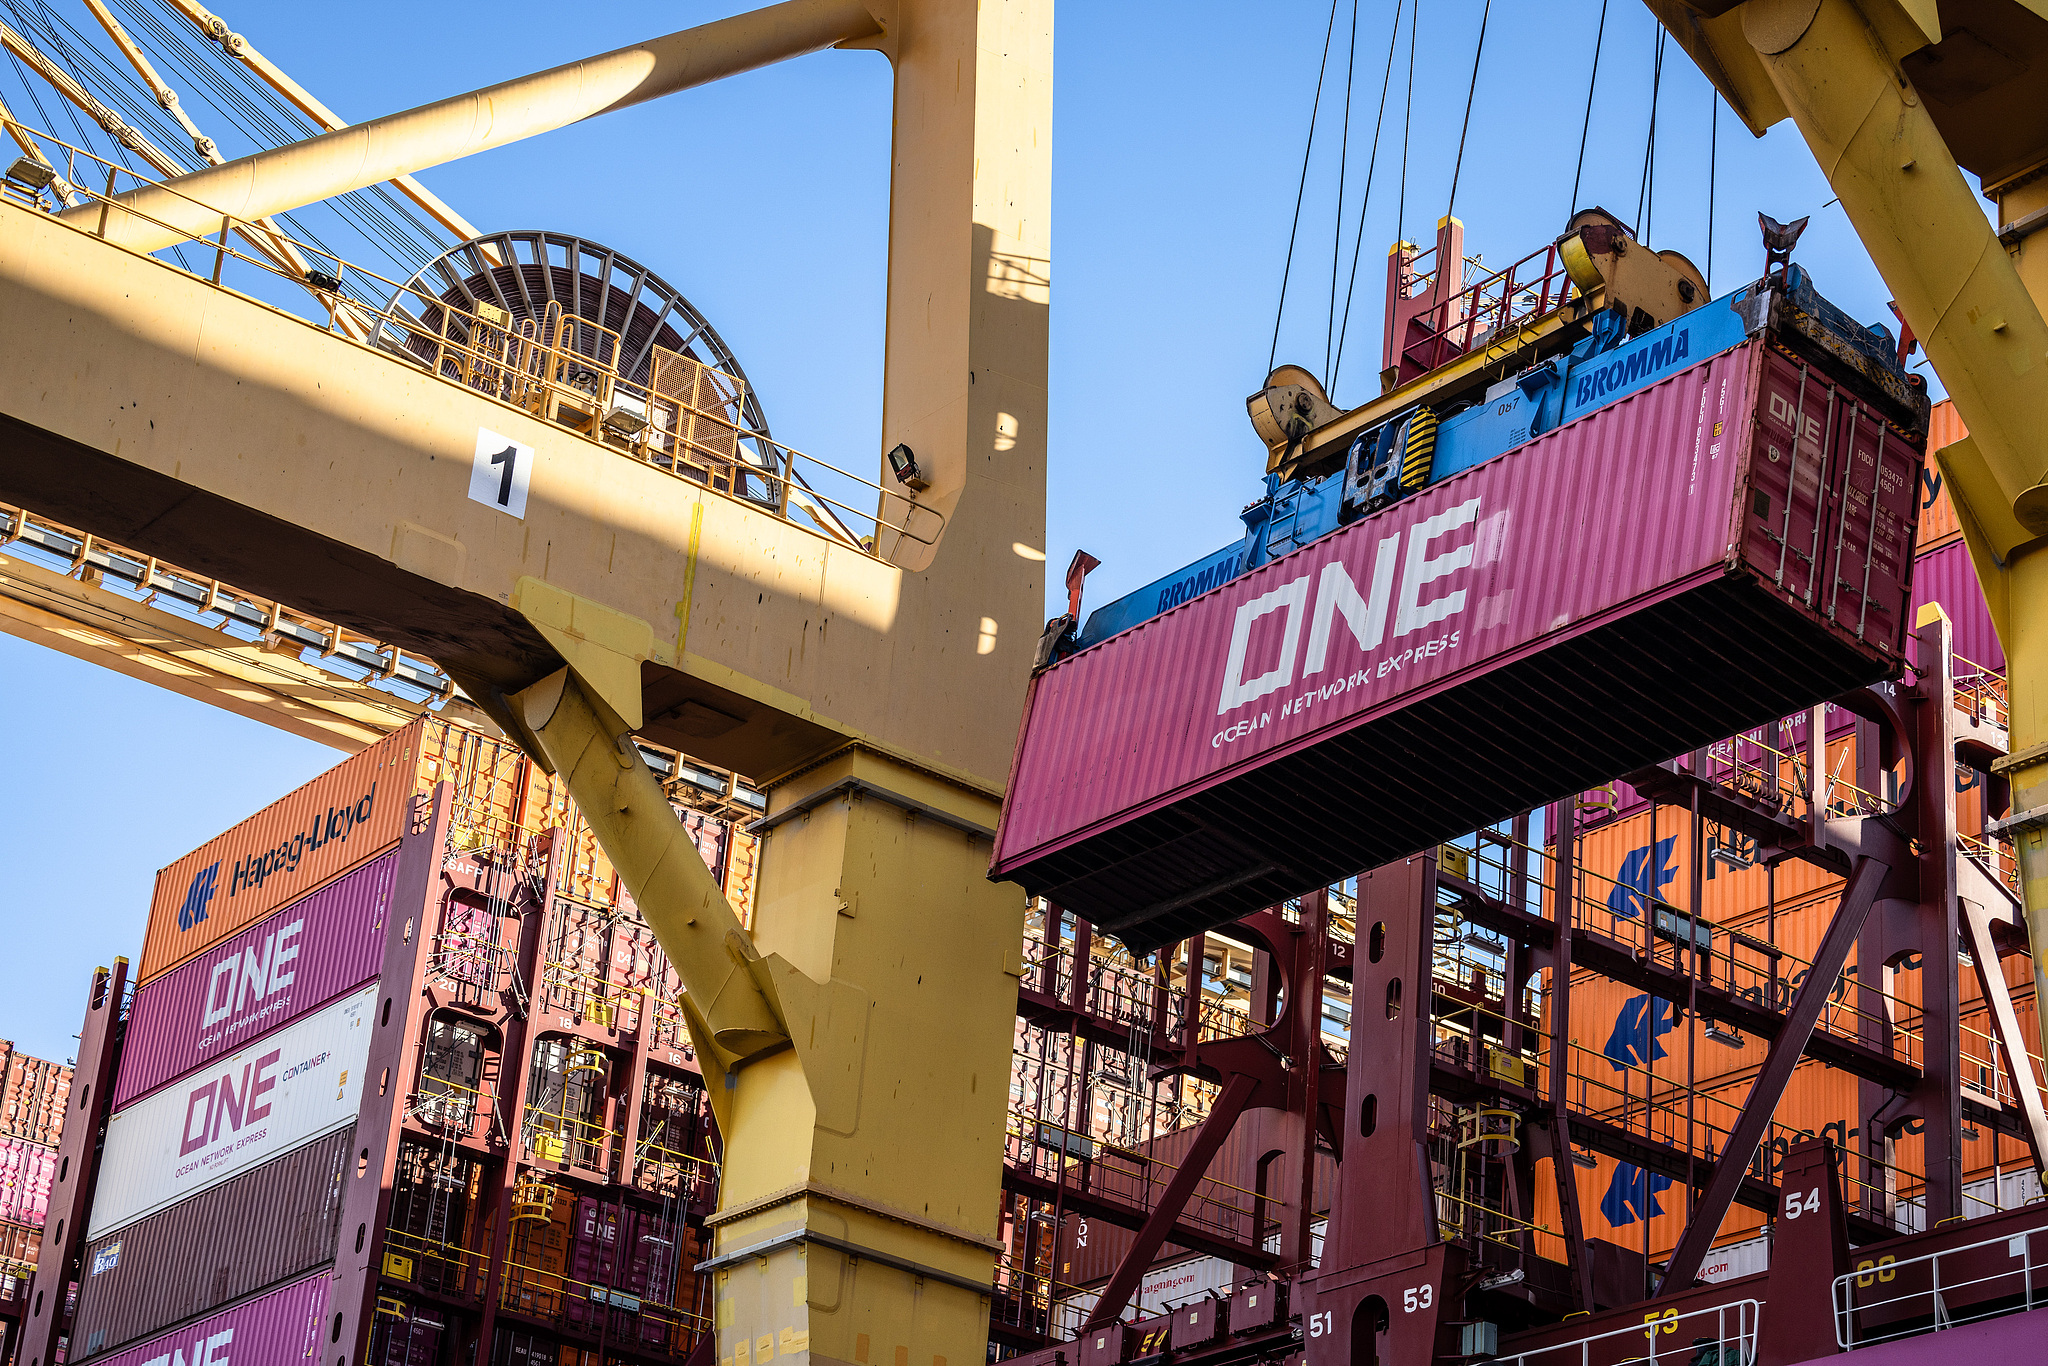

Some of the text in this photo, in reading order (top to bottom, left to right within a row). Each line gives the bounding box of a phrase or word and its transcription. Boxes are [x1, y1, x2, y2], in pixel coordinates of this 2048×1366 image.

[1575, 328, 1689, 409] BROMMA
[1769, 391, 1820, 445] ONE
[490, 445, 517, 506] 1
[1858, 449, 1874, 467] FOCU
[1880, 465, 1903, 487] 053473
[1880, 479, 1895, 495] 45G1
[1217, 495, 1482, 716] ONE
[1211, 630, 1460, 749] OCEAN NETWORK EXPRESS
[1882, 680, 1896, 697] 14
[1991, 731, 2005, 749] 12
[229, 781, 376, 897] Hapag-Lloyd
[1332, 943, 1346, 958] 12
[202, 918, 304, 1030] ONE
[438, 978, 458, 993] 20
[1433, 982, 1446, 995] 10
[558, 1016, 573, 1030] 18
[667, 1052, 682, 1066] 16
[179, 1047, 281, 1158] ONE
[175, 1127, 268, 1179] OCEAN NETWORK EXPRESS
[1785, 1187, 1820, 1220] 54
[1403, 1283, 1433, 1313] 53
[1309, 1310, 1332, 1338] 51
[1644, 1307, 1679, 1339] 53
[1141, 1329, 1169, 1352] 54
